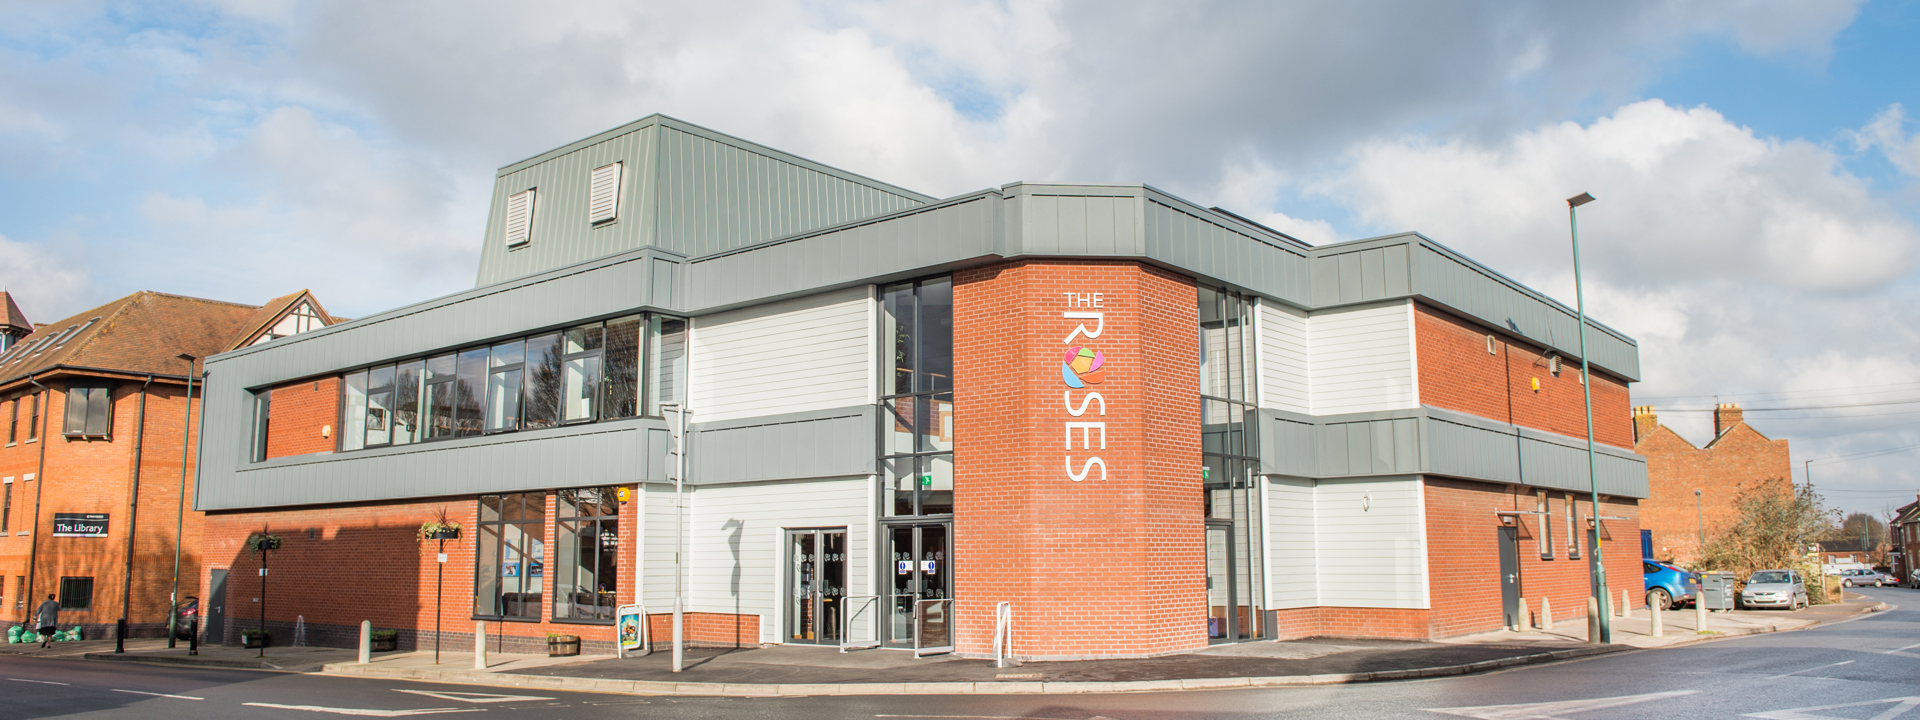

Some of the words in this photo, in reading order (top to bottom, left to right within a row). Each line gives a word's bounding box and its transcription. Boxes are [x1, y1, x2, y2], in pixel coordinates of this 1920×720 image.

[1063, 292, 1104, 309] THE
[57, 523, 73, 532] The
[73, 523, 103, 534] Library
